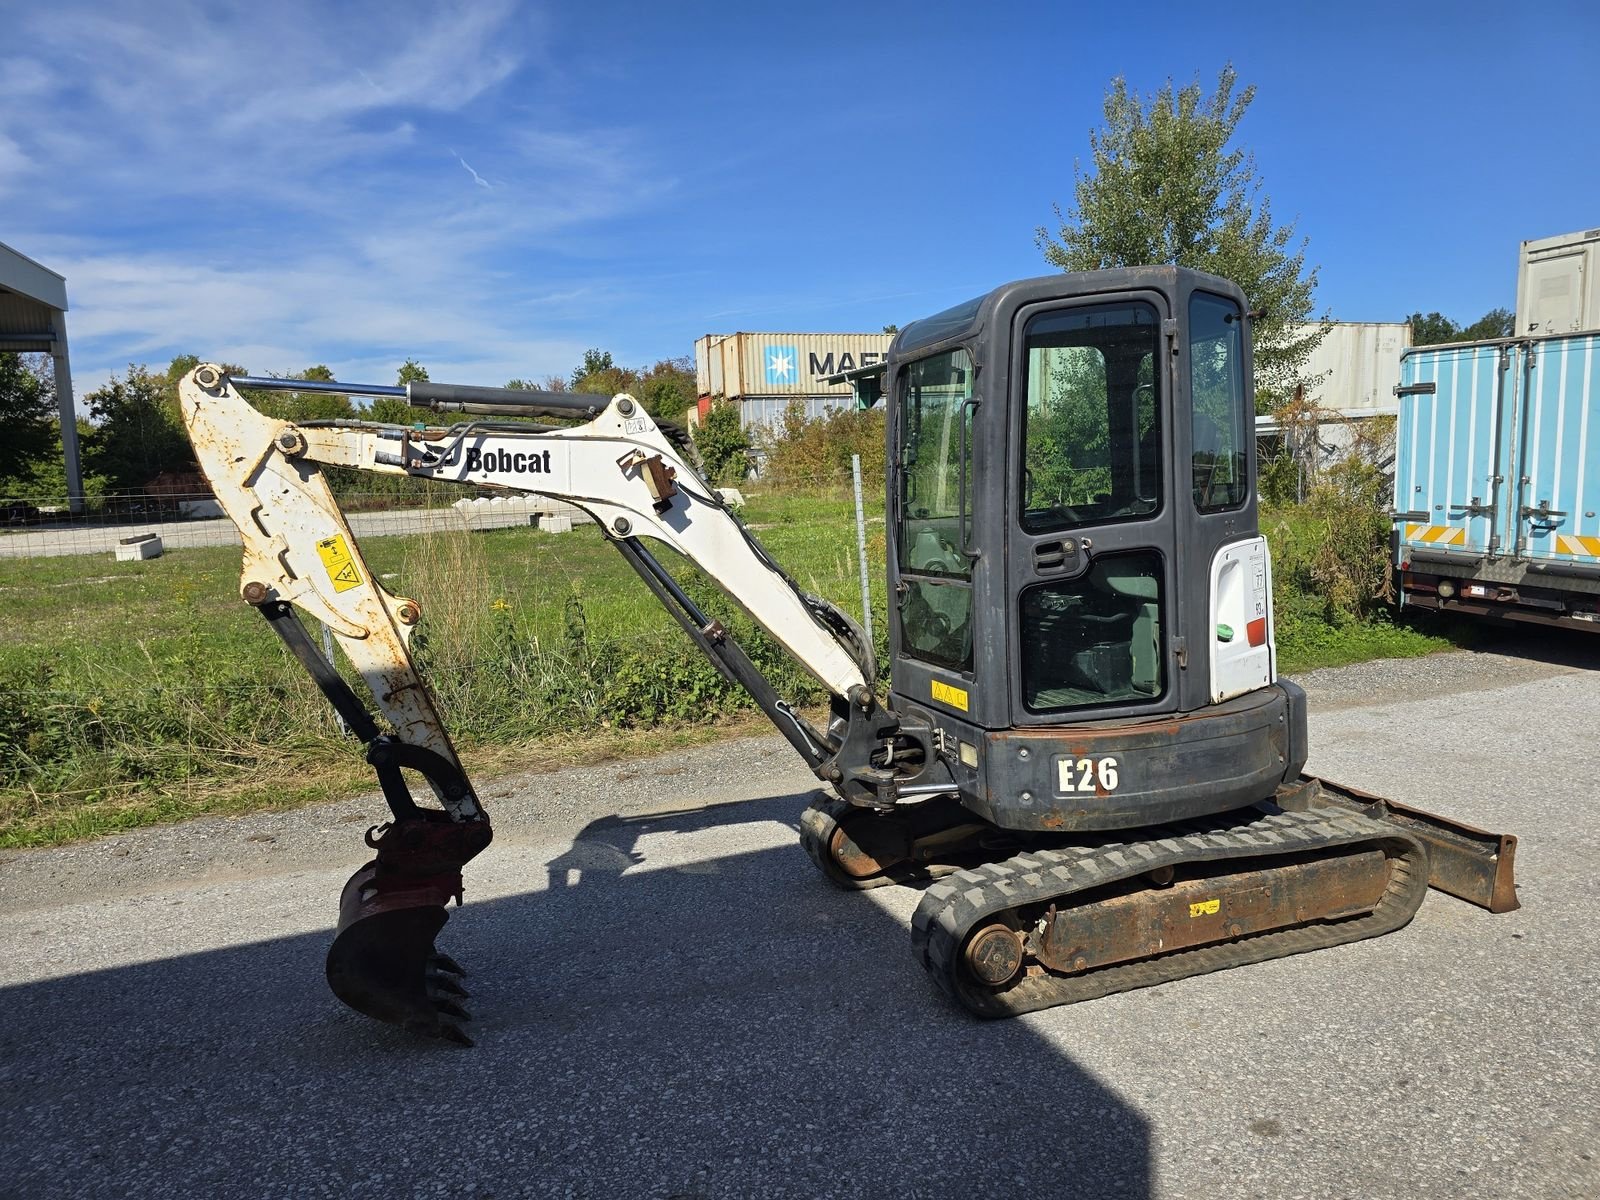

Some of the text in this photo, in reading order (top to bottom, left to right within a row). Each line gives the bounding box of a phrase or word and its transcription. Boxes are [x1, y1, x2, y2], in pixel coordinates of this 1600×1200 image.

[809, 352, 889, 375] MAE
[466, 447, 551, 473] Bobcat
[1058, 757, 1119, 792] E26
